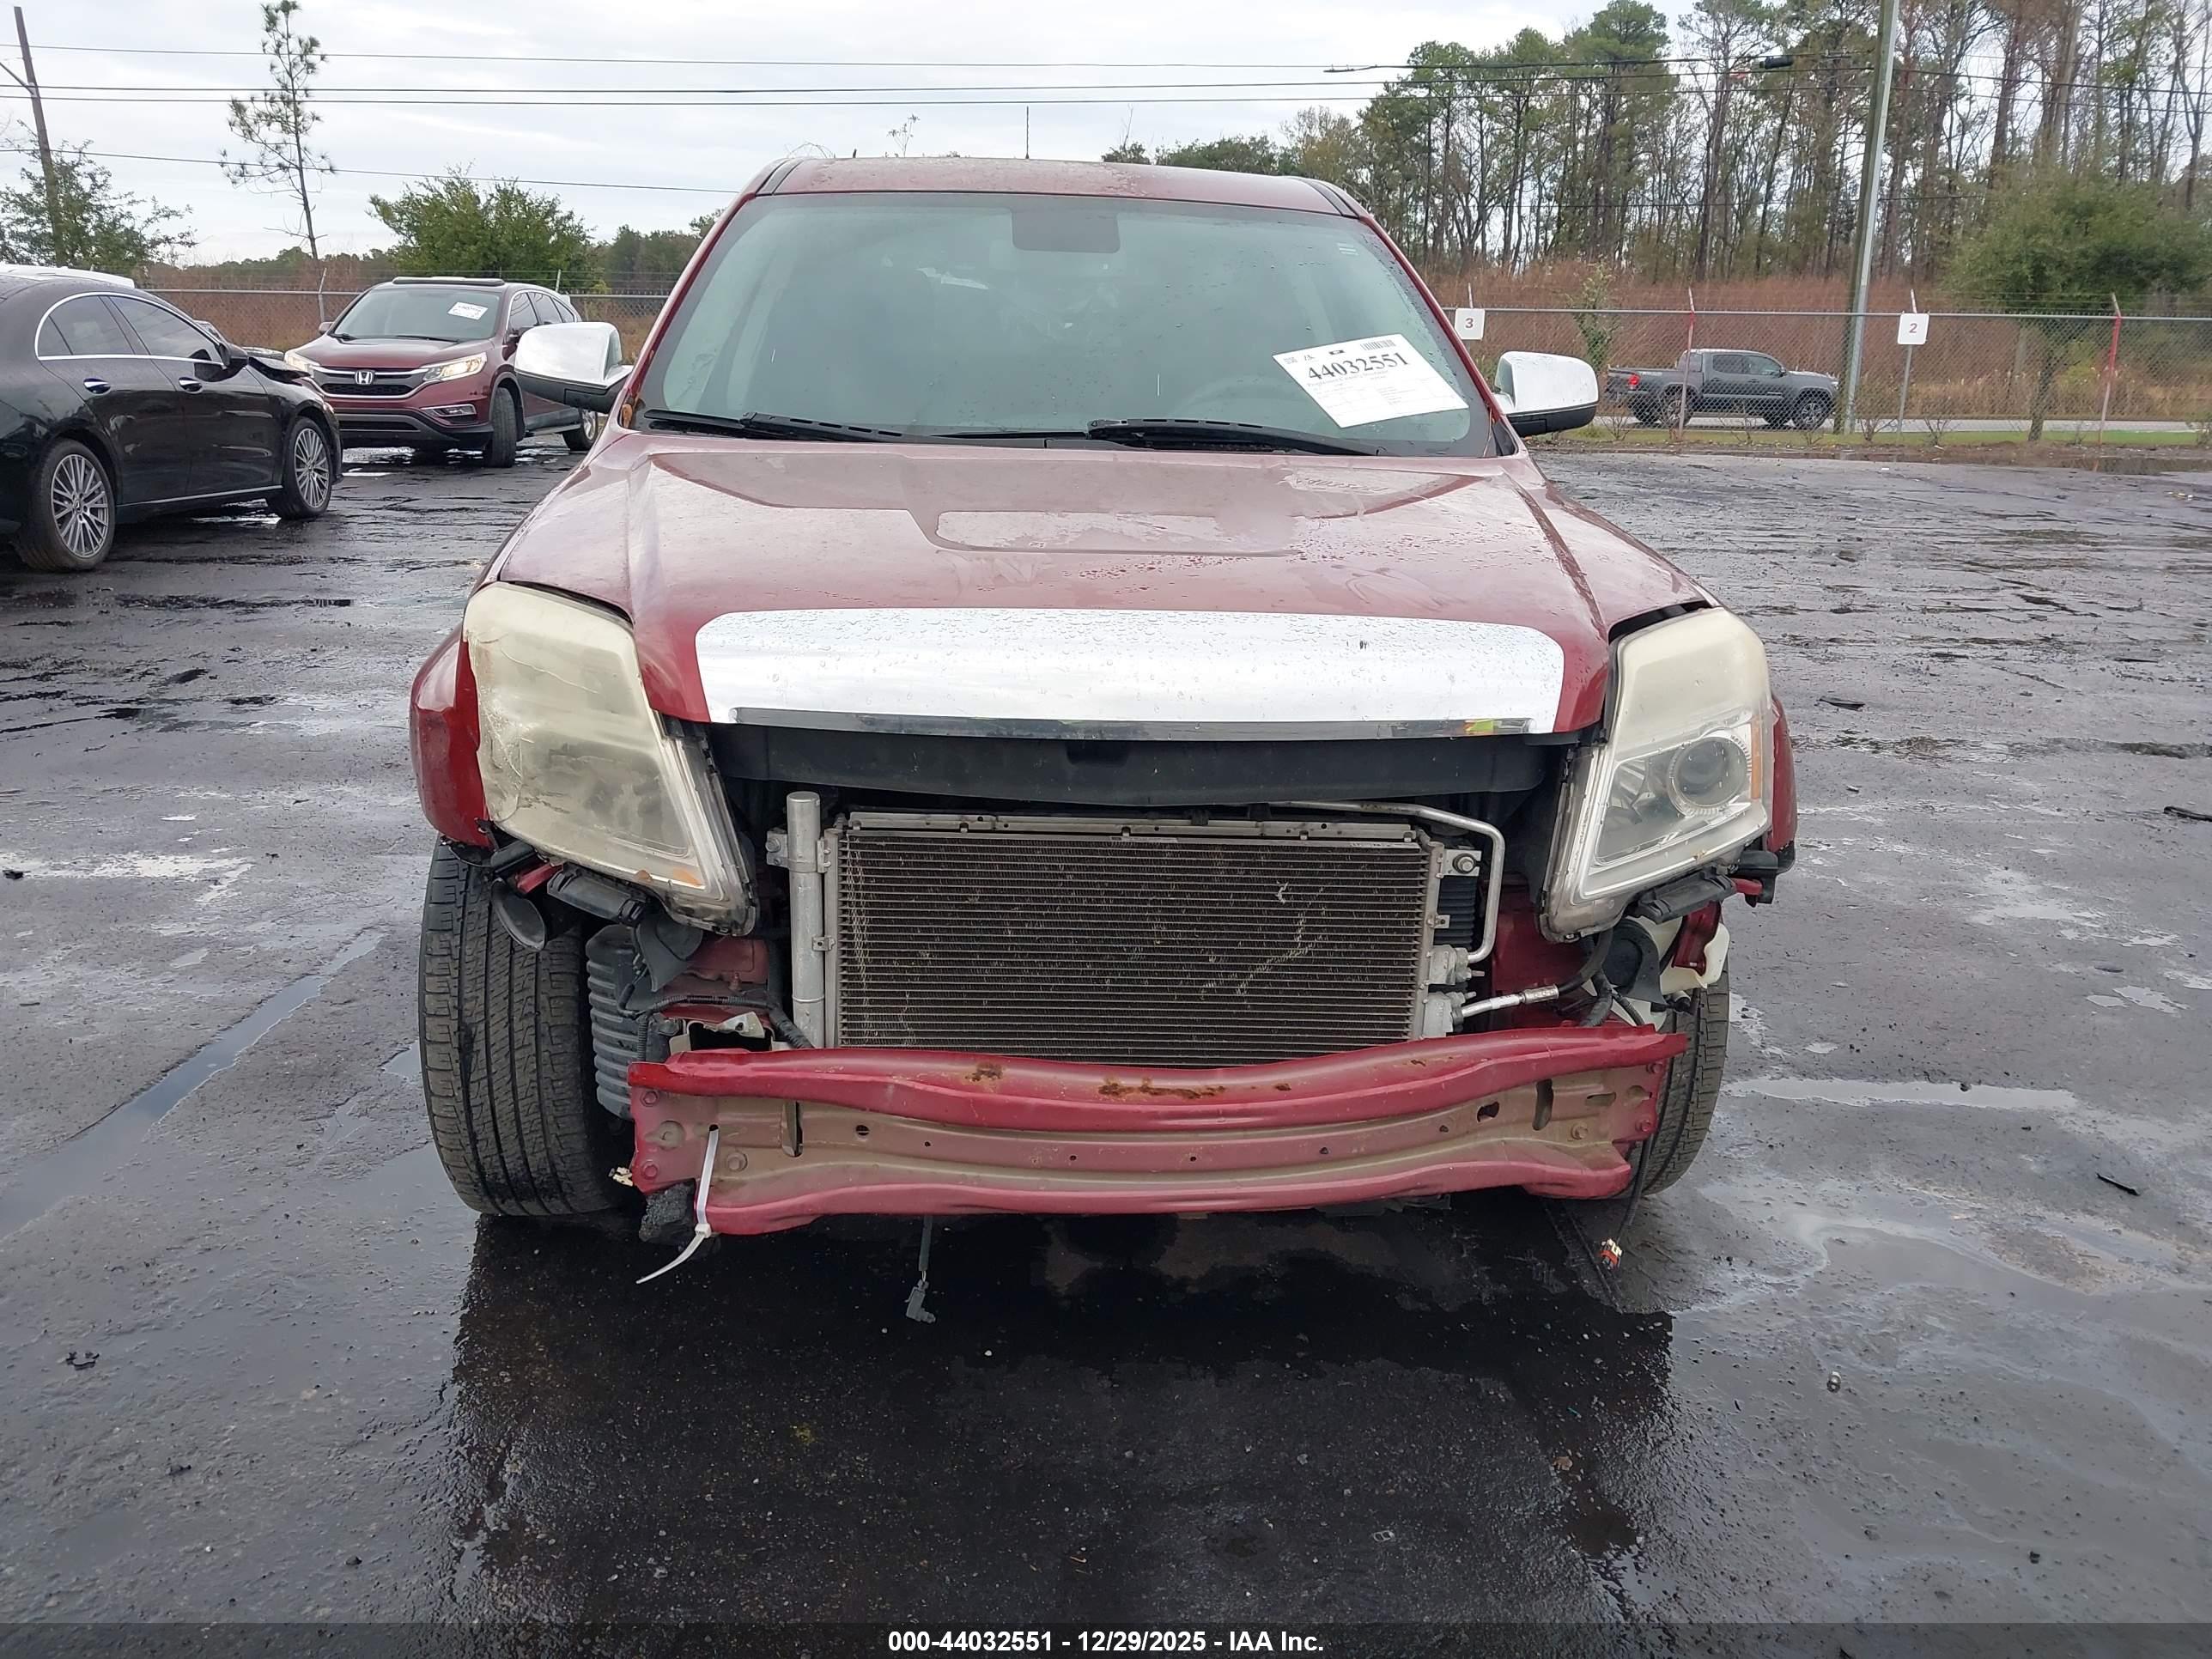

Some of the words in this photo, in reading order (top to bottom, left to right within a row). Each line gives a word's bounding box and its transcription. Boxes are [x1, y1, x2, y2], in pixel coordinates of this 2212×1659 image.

[1465, 317, 1474, 329] 3
[1909, 322, 1917, 334] 2
[1309, 352, 1408, 380] 44032551
